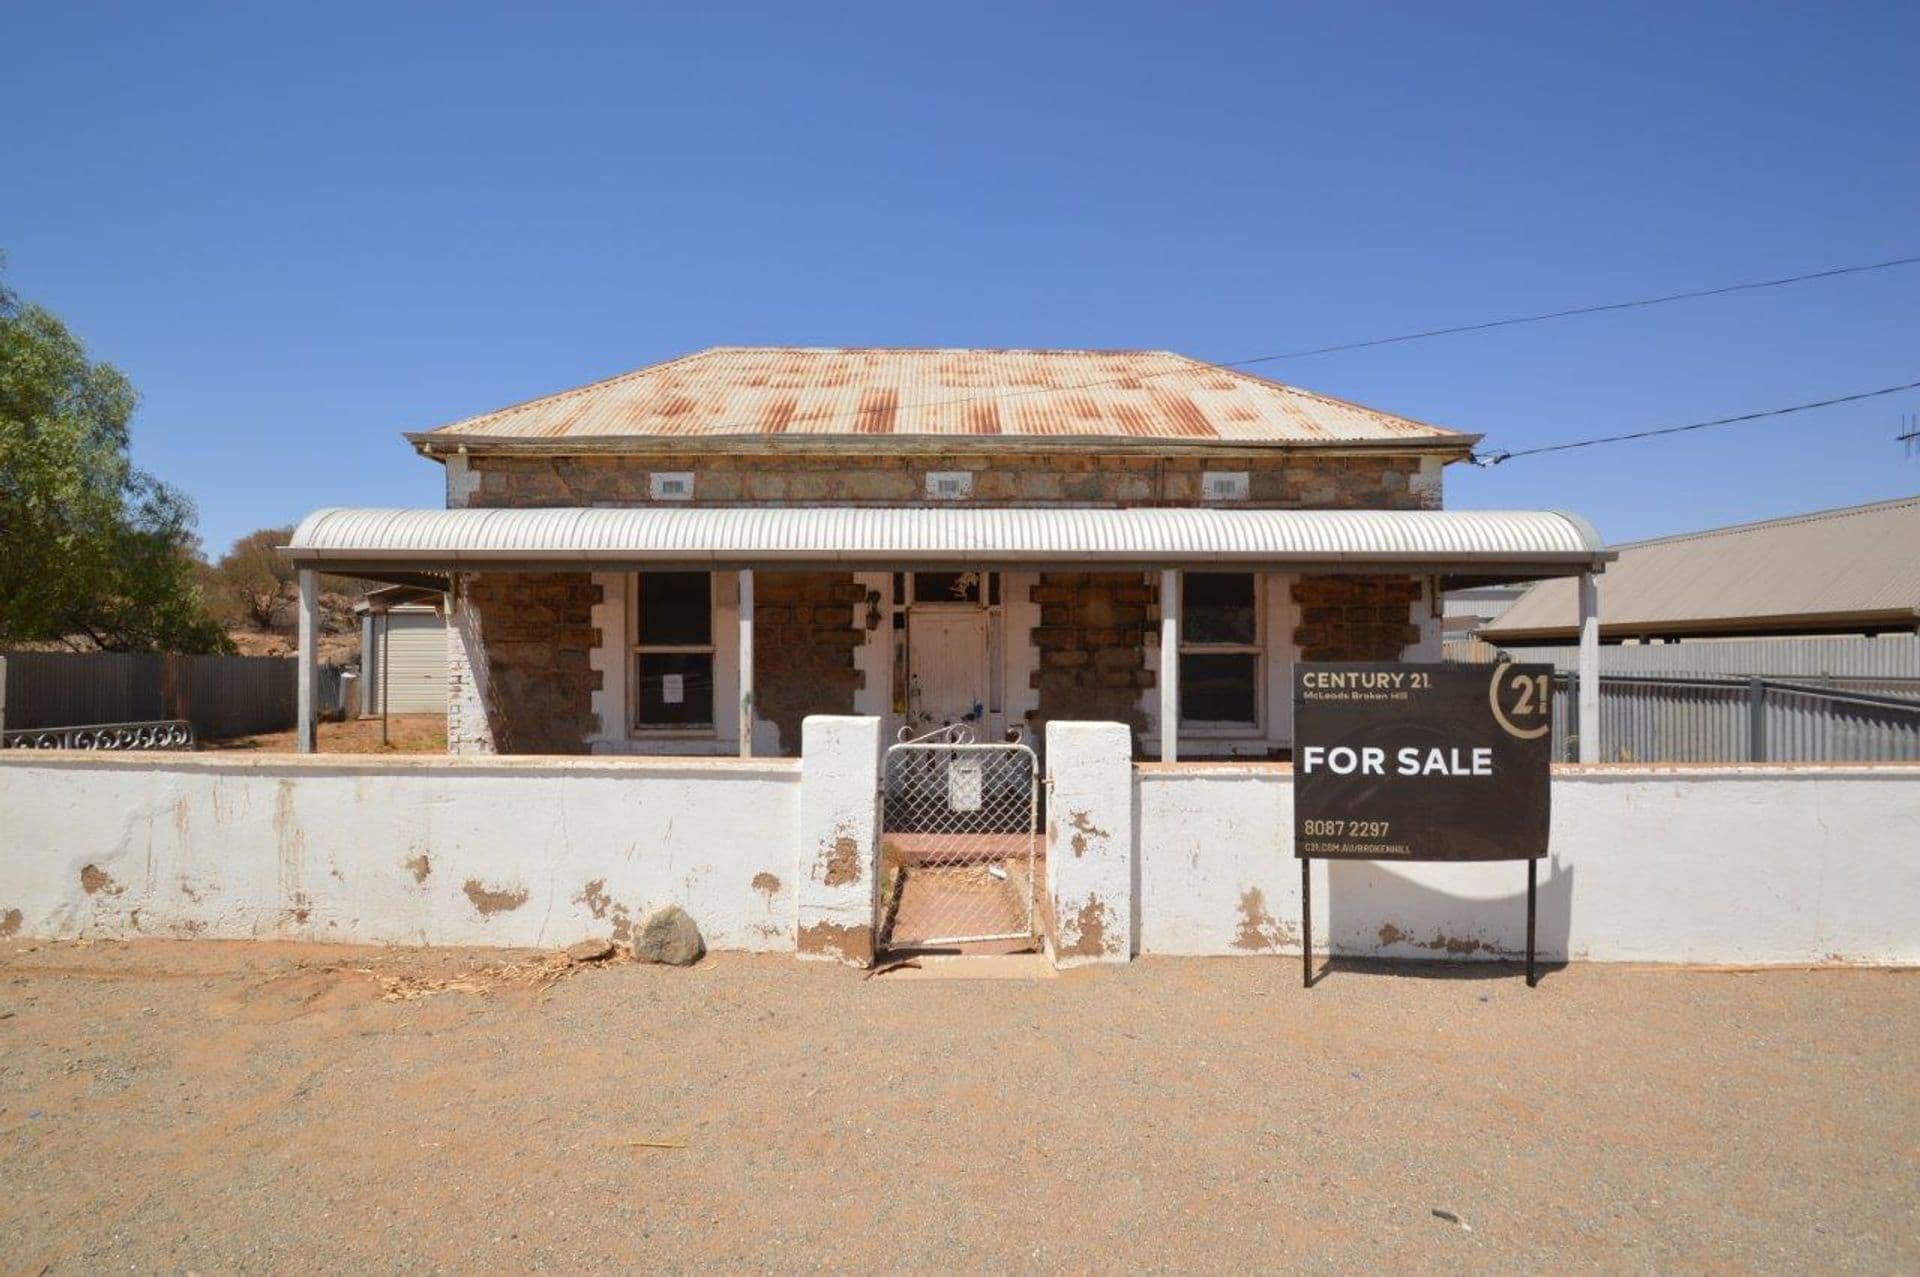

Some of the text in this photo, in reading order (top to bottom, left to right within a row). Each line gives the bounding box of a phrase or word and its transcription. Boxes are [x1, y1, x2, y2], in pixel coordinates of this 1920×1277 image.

[1303, 672, 1404, 688] CENTURY
[1352, 691, 1388, 700] Broken
[1390, 691, 1408, 700] Hill
[1303, 746, 1492, 775] FOR SALE
[1304, 820, 1389, 837] 8087 2297
